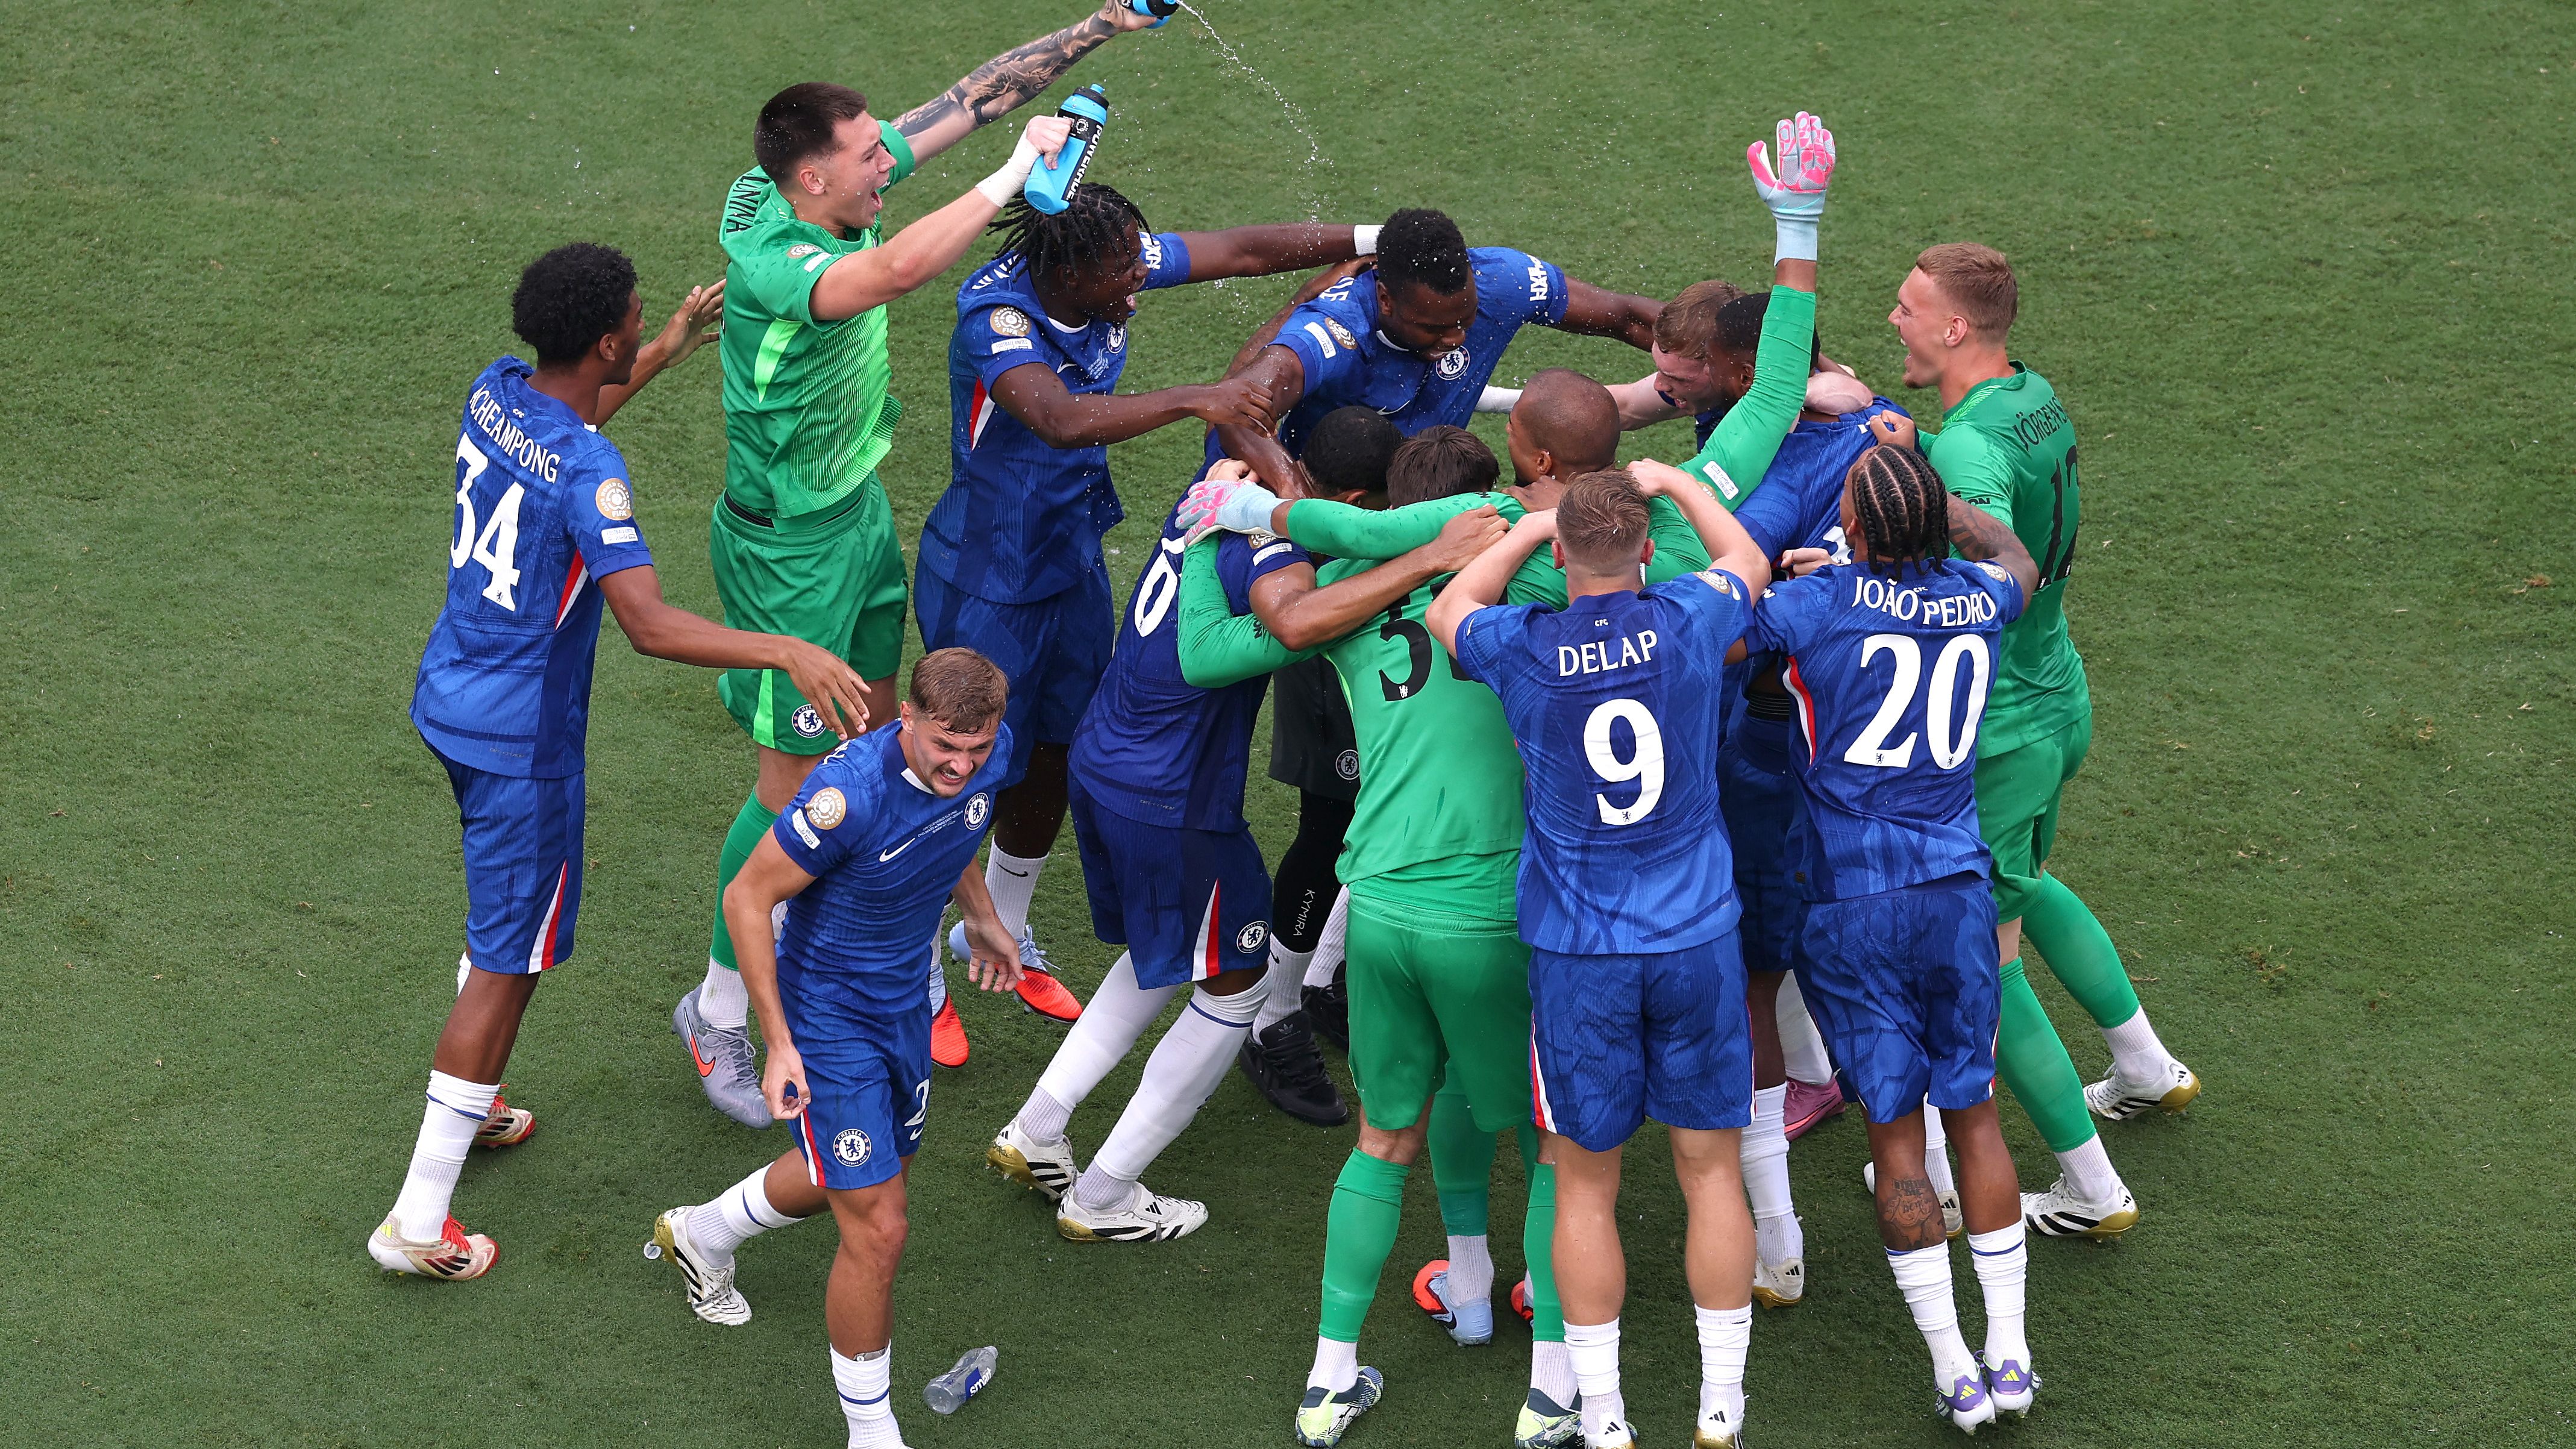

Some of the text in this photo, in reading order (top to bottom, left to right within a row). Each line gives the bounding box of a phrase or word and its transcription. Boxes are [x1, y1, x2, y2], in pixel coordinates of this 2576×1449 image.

[995, 306, 1014, 316] WORLD
[1002, 327, 1018, 336] FIFA
[469, 383, 561, 484] ACHEAMPONG
[2012, 396, 2069, 452] JÖRGENS
[451, 431, 525, 612] 34
[1851, 576, 1996, 627] JOÃO PEDRO
[1594, 618, 1609, 627] CFC
[1558, 630, 1658, 677] DELAP
[798, 705, 812, 713] CHEL
[1843, 633, 1989, 769] 20
[1583, 698, 1665, 825] 9
[821, 790, 838, 799] WORLD
[968, 793, 985, 806] CHELSEA
[809, 809, 821, 825] FIFA
[1293, 889, 1315, 936] KYMIRA
[904, 1078, 930, 1126] 2
[838, 1130, 862, 1141] CHELSEA
[970, 1366, 992, 1397] smart
